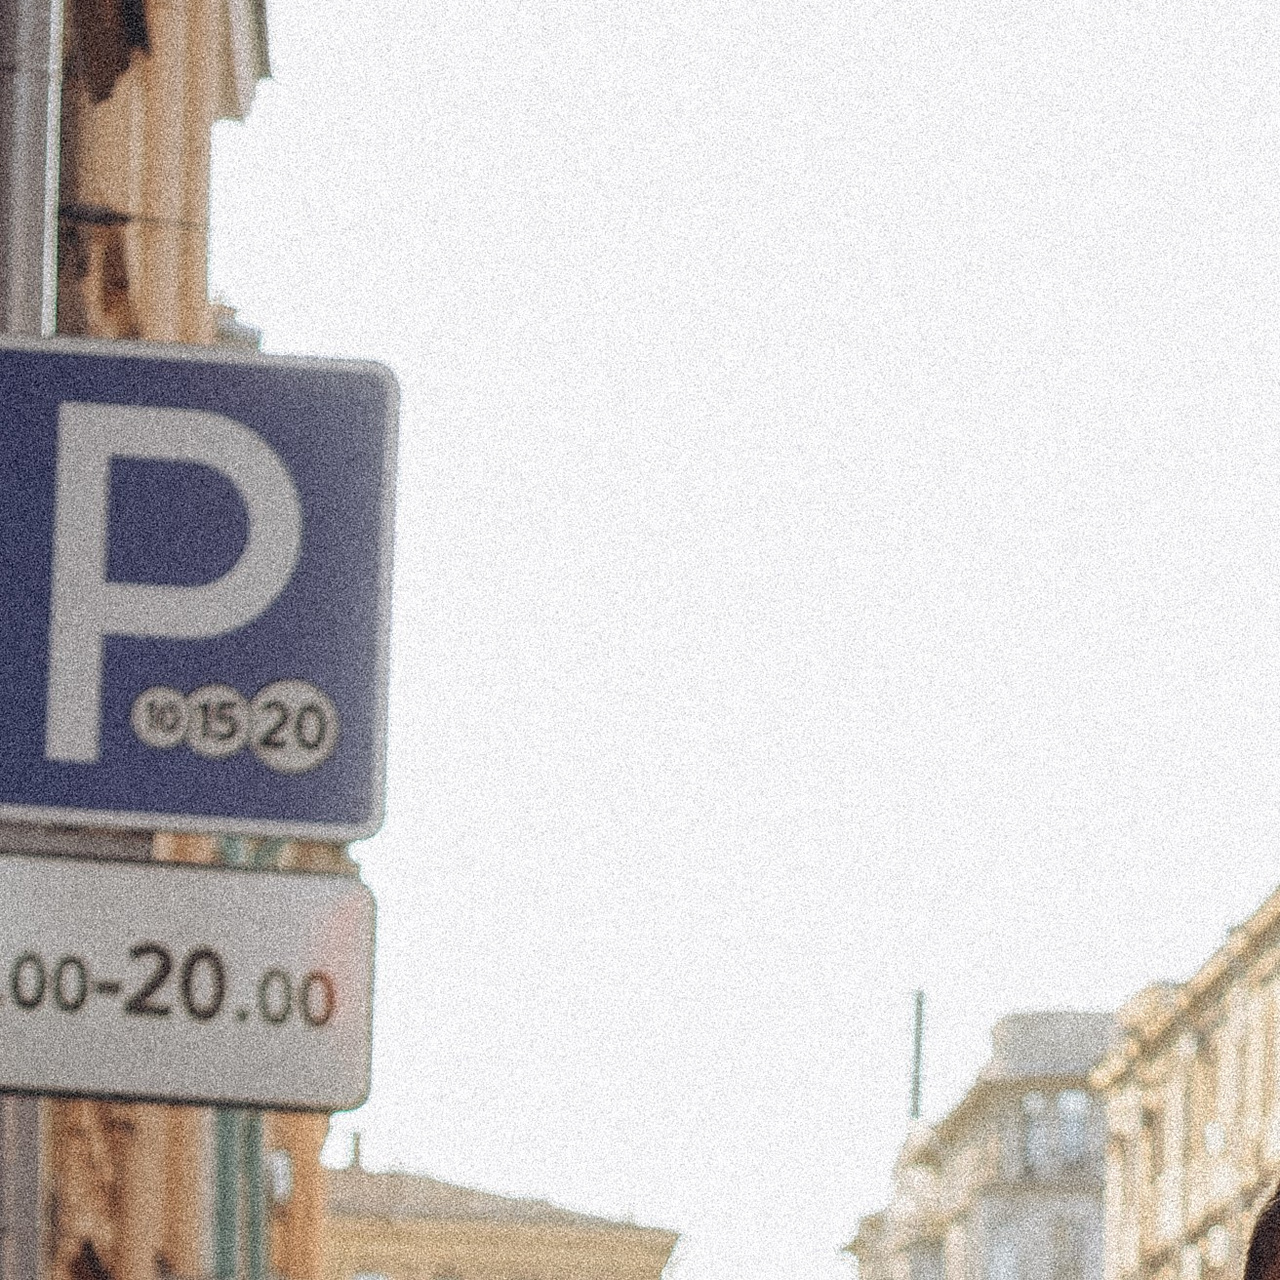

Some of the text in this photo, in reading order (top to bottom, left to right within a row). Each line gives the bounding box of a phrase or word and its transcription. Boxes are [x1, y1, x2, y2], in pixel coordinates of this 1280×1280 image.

[45, 399, 303, 763] P
[146, 700, 327, 750] 10 15 20
[0, 942, 337, 1027] 00-20.00
